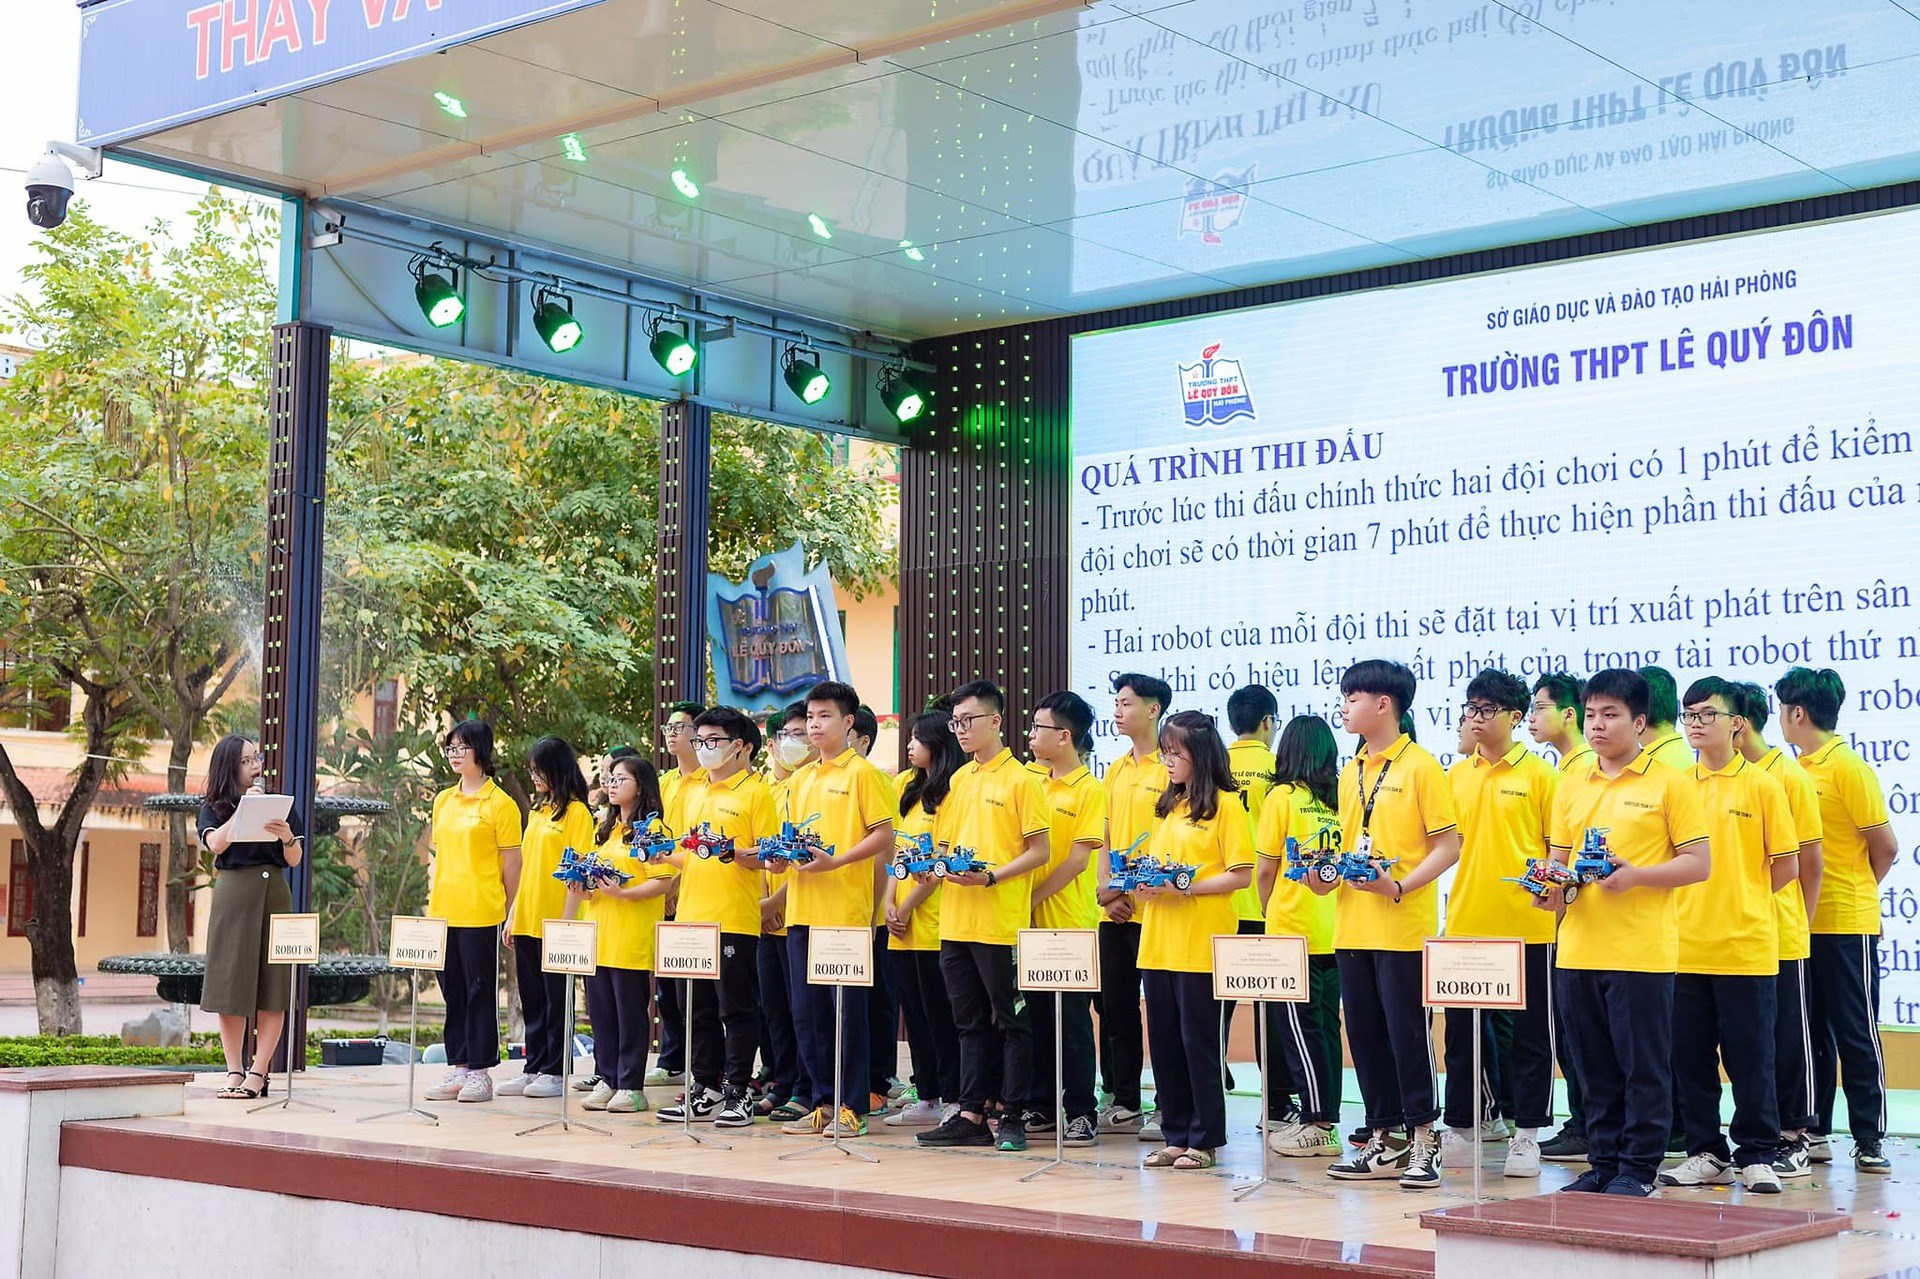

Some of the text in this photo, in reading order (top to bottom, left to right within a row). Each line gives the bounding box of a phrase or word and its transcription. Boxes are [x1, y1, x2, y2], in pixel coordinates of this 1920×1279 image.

[1513, 300, 1550, 326] GIÁO
[1556, 298, 1589, 323] DỤC
[1595, 290, 1616, 316] VÀ
[1621, 288, 1656, 312] ĐÀO
[1661, 284, 1694, 309] TẠO
[1700, 276, 1729, 300] HẢI
[1735, 269, 1797, 296] PHÒNG
[1442, 309, 1854, 397] TRƯỜNG THPT LÊ QUÝ ĐÔN
[1081, 427, 1384, 495] QUÁ TRÌNH THI ĐẤU
[1097, 502, 1163, 531] Trước
[1172, 497, 1206, 523] lúc
[1215, 492, 1245, 519] thi
[1253, 482, 1297, 515] đấu
[1306, 477, 1375, 509] chính
[1385, 470, 1441, 502] thức
[1452, 464, 1491, 496] hai
[1502, 458, 1545, 495] đội
[1556, 452, 1618, 487] chơi
[1629, 448, 1663, 479] có
[1678, 446, 1688, 475] 1
[1703, 438, 1772, 480] phút
[1782, 424, 1820, 464] để
[1831, 418, 1912, 460] kiểm
[1081, 545, 1115, 576] đội
[1123, 538, 1172, 569] chơi
[1180, 535, 1203, 564] sẽ
[1212, 534, 1239, 562] có
[1248, 529, 1295, 559] thời
[1304, 527, 1357, 562] gian
[1367, 522, 1381, 550] 7
[1390, 514, 1449, 555] phút
[1458, 504, 1491, 541] để
[1500, 509, 1561, 541] thực
[1571, 501, 1633, 534] hiện
[1643, 486, 1716, 534] phần
[1729, 488, 1767, 518] thi
[1779, 474, 1836, 515] đấu
[1848, 475, 1905, 508] của
[1081, 588, 1136, 621] phút.
[1104, 628, 1143, 655] Hai
[1151, 625, 1212, 652] robot
[1220, 619, 1262, 648] của
[1270, 611, 1317, 646] mỗi
[1326, 612, 1366, 642] đội
[1376, 610, 1409, 639] thi
[1419, 607, 1445, 634] sẽ
[1454, 605, 1496, 639] đặt
[1507, 599, 1541, 635] tại
[1550, 599, 1576, 632] vị
[1588, 595, 1618, 626] trí
[1630, 584, 1694, 624] xuất
[1705, 586, 1773, 627] phát
[1783, 582, 1845, 615] trên
[1856, 578, 1910, 610] sân
[1161, 666, 1196, 692] khi
[1208, 665, 1236, 690] có
[1249, 662, 1300, 690] hiệu
[1313, 657, 1354, 689] lện
[1521, 647, 1569, 675] của
[1676, 638, 1713, 669] tài
[1728, 635, 1813, 666] robot
[1828, 629, 1882, 661] thứ
[1849, 732, 1911, 768] hực
[275, 945, 302, 956] ROBOT
[396, 948, 438, 961] ROBOT 07
[548, 952, 590, 966] ROBOT 06
[663, 956, 712, 969] ROBOT 05
[814, 963, 864, 976] ROBOT 04
[1027, 969, 1088, 983] ROBOT 03
[1225, 976, 1296, 990] ROBOT 02
[1436, 981, 1511, 996] ROBOT 01
